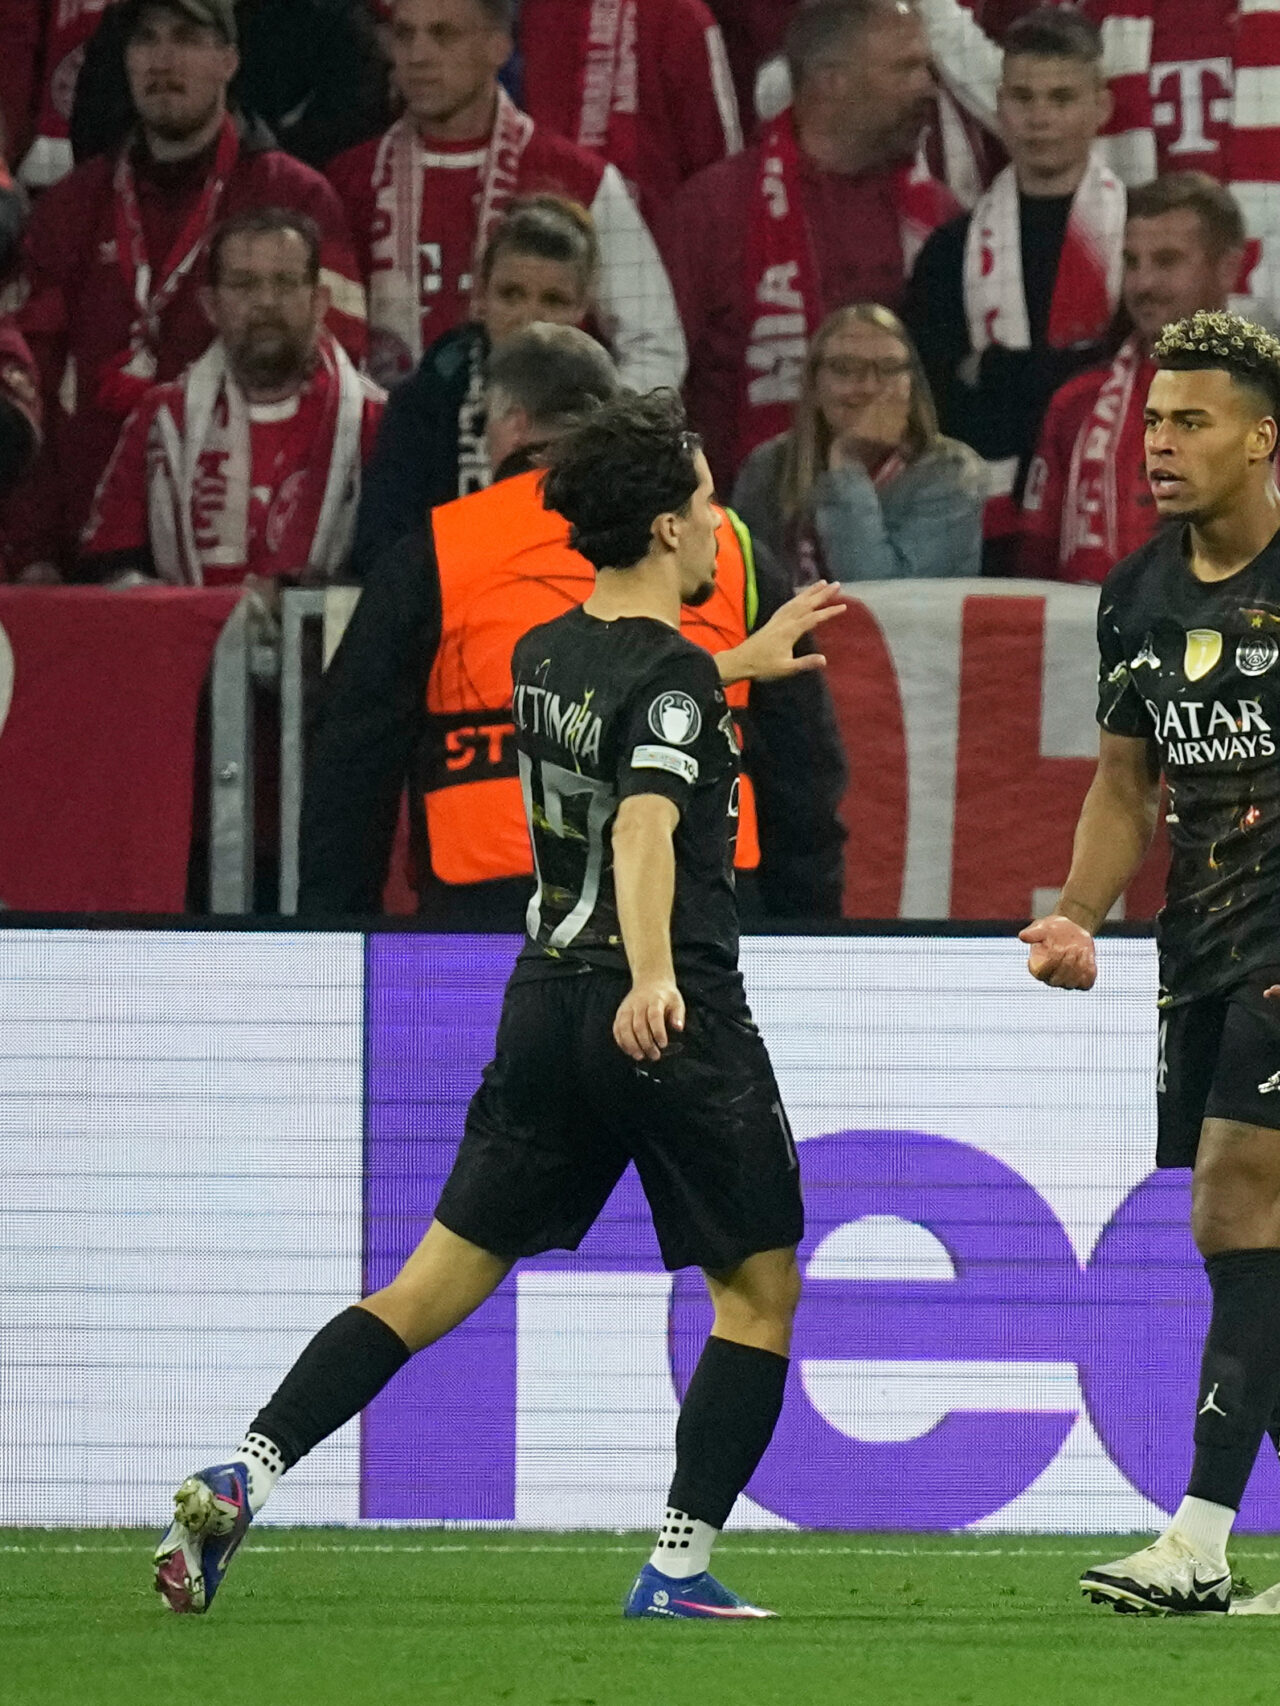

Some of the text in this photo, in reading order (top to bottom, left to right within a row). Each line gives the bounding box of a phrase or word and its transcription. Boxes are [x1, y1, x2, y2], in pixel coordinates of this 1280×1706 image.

[512, 684, 602, 765] ITINHA
[1168, 733, 1276, 765] AIRWAYS
[518, 749, 616, 948] 17
